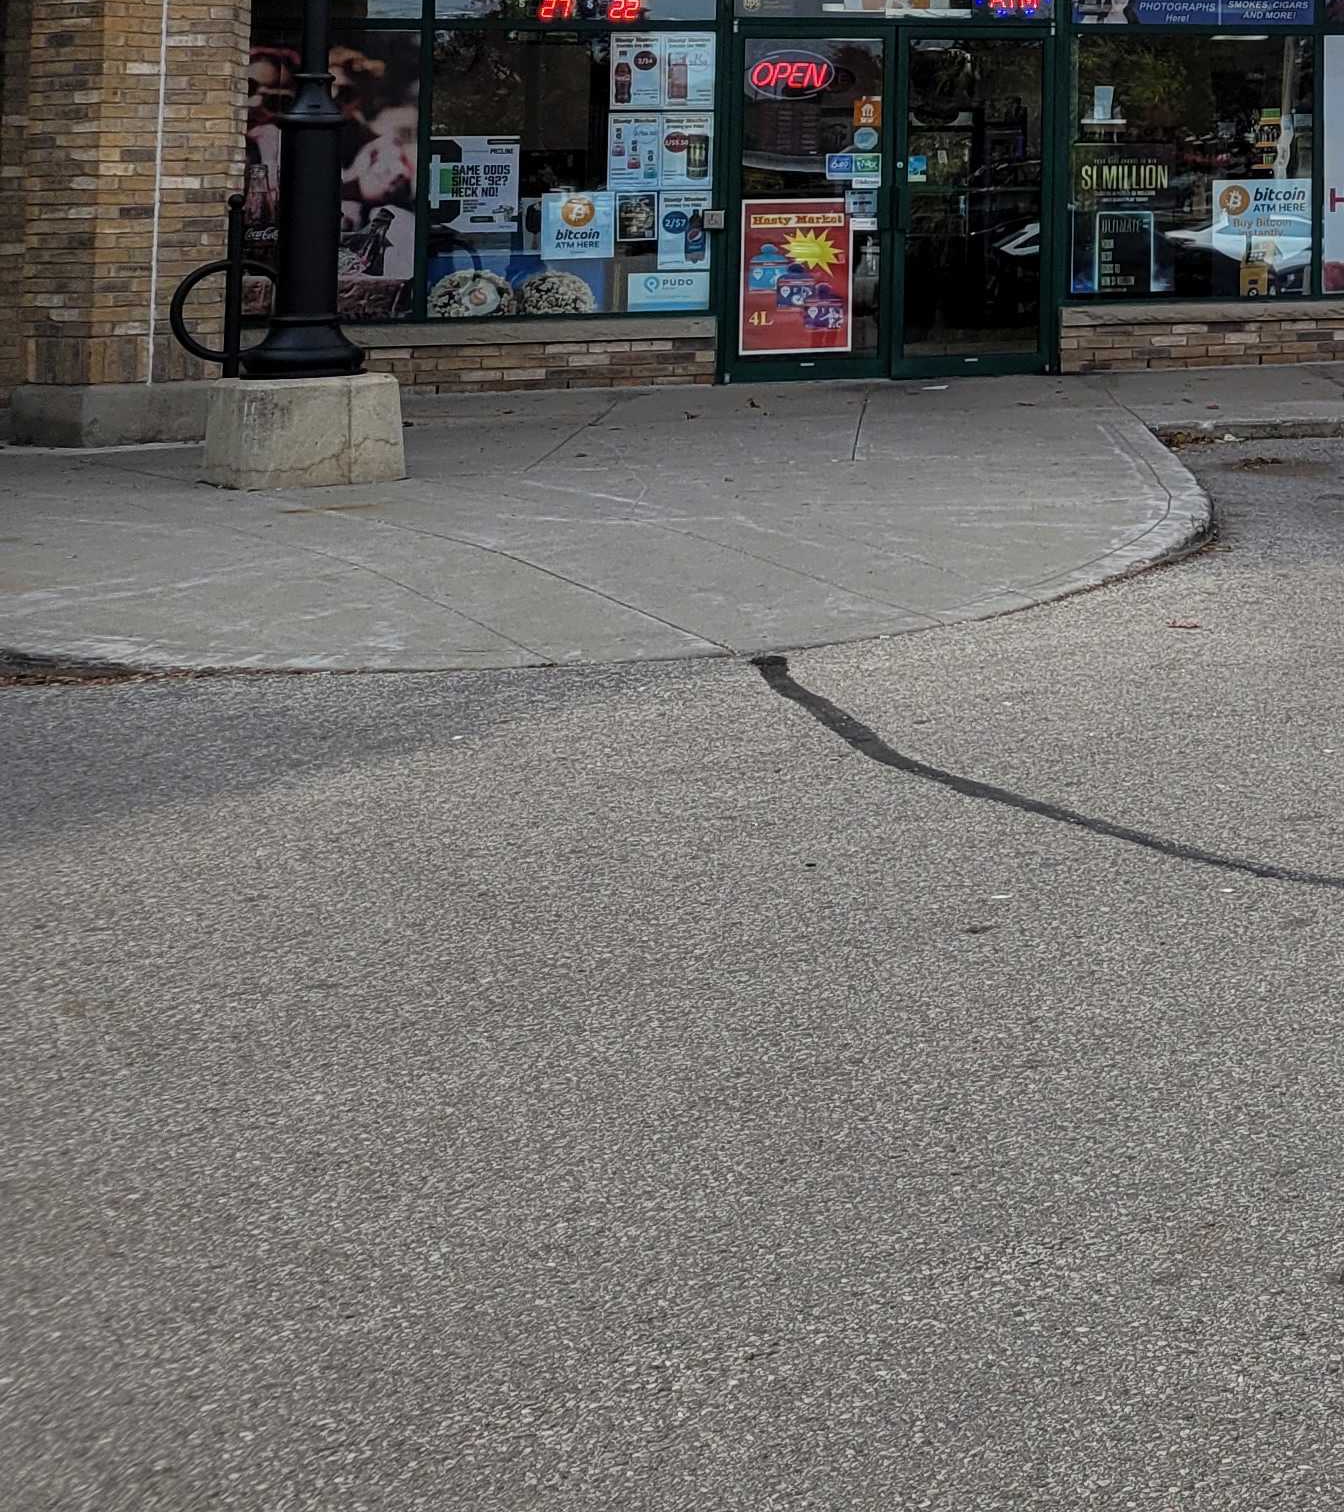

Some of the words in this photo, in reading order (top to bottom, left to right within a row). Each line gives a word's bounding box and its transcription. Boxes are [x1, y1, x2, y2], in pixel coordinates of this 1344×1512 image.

[1139, 2, 1216, 13] PHOTOGRAPHS
[1272, 0, 1309, 10] CIGARS
[1242, 11, 1264, 20] AND
[1265, 11, 1297, 21] MORE!
[752, 62, 829, 88] OPEN
[452, 165, 481, 175] SAME
[483, 165, 511, 175] ODDS
[452, 176, 482, 186] SINCE
[1102, 165, 1169, 190] MILLION
[452, 187, 478, 197] HECK
[1254, 187, 1306, 202] bitcoin
[1253, 204, 1276, 212] ATM
[1278, 203, 1306, 212] HERE
[752, 215, 791, 226] Hasty
[796, 214, 843, 224] Market
[555, 229, 600, 240] bitcoin
[555, 241, 575, 249] ATM
[576, 240, 600, 249] HERE
[662, 278, 694, 287] PUDO
[749, 311, 774, 326] 4L
